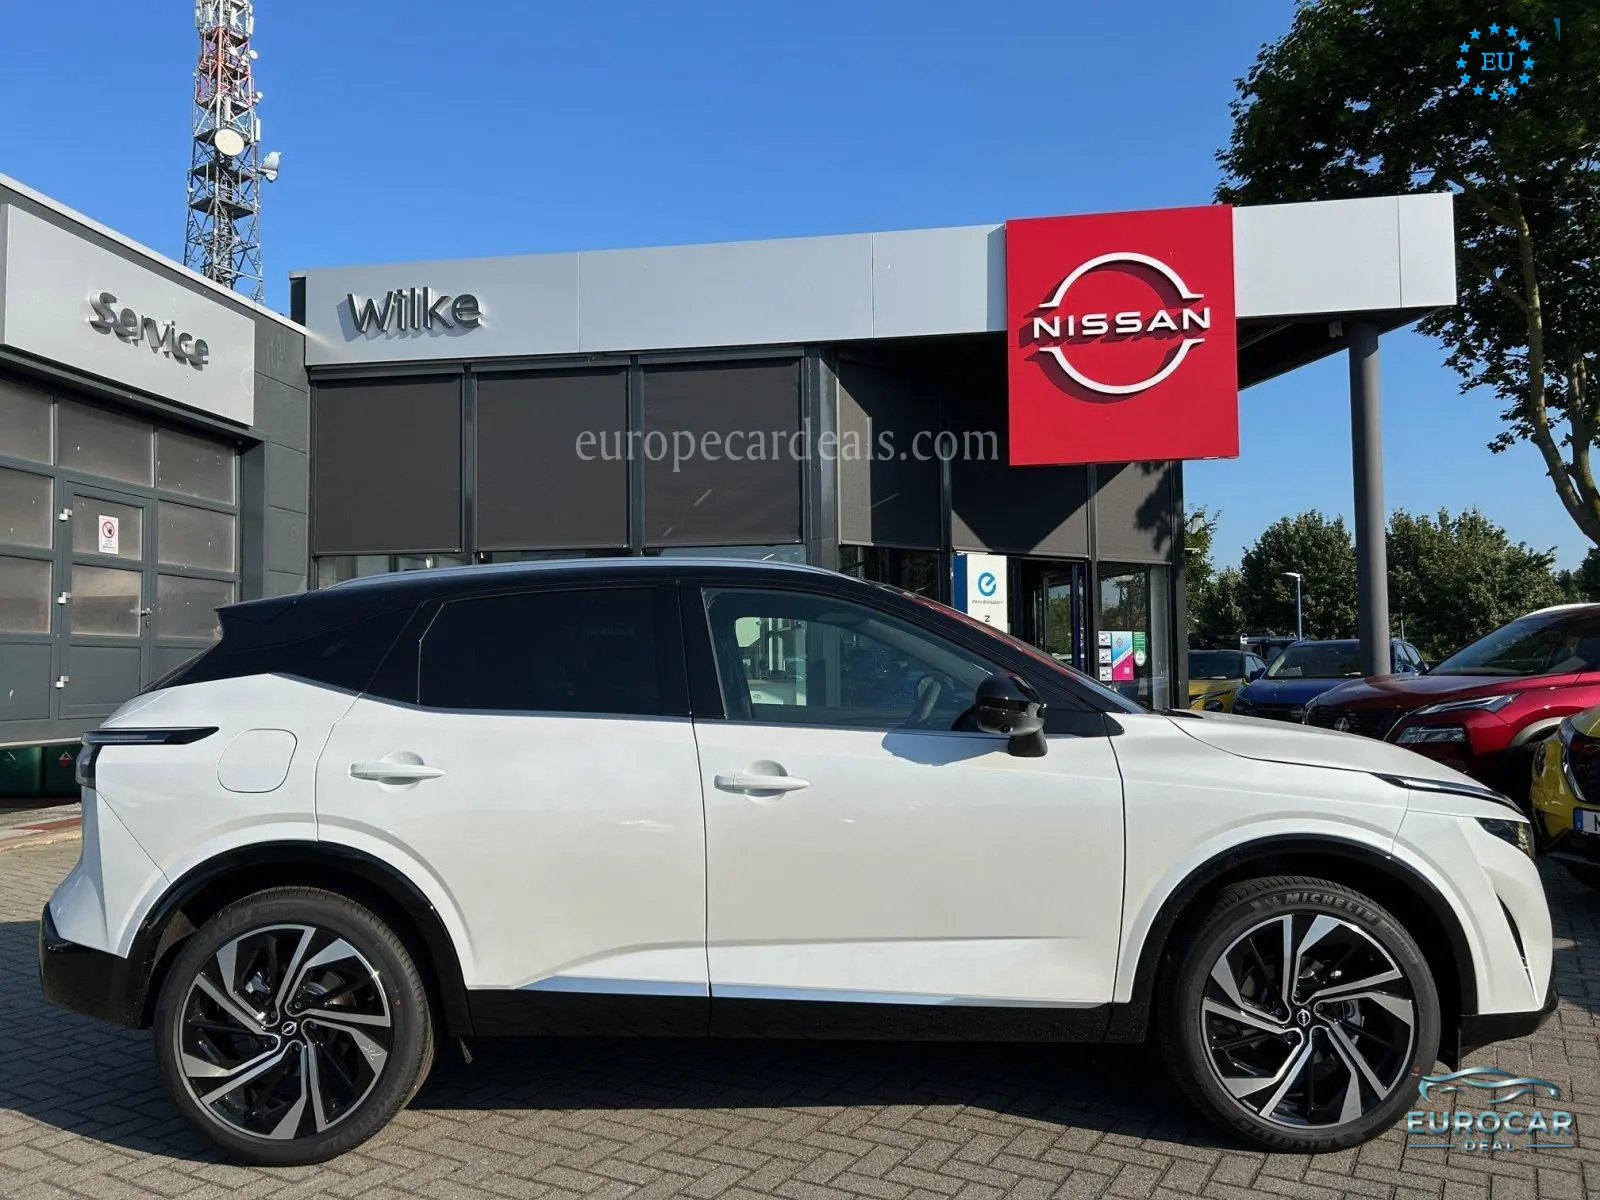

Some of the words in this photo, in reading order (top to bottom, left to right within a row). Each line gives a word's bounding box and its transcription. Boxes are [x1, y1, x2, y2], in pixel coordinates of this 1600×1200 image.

[347, 287, 482, 333] Wilke
[1033, 307, 1210, 338] NISSAN
[89, 292, 209, 371] Service
[1286, 893, 1377, 924] MICHELIN
